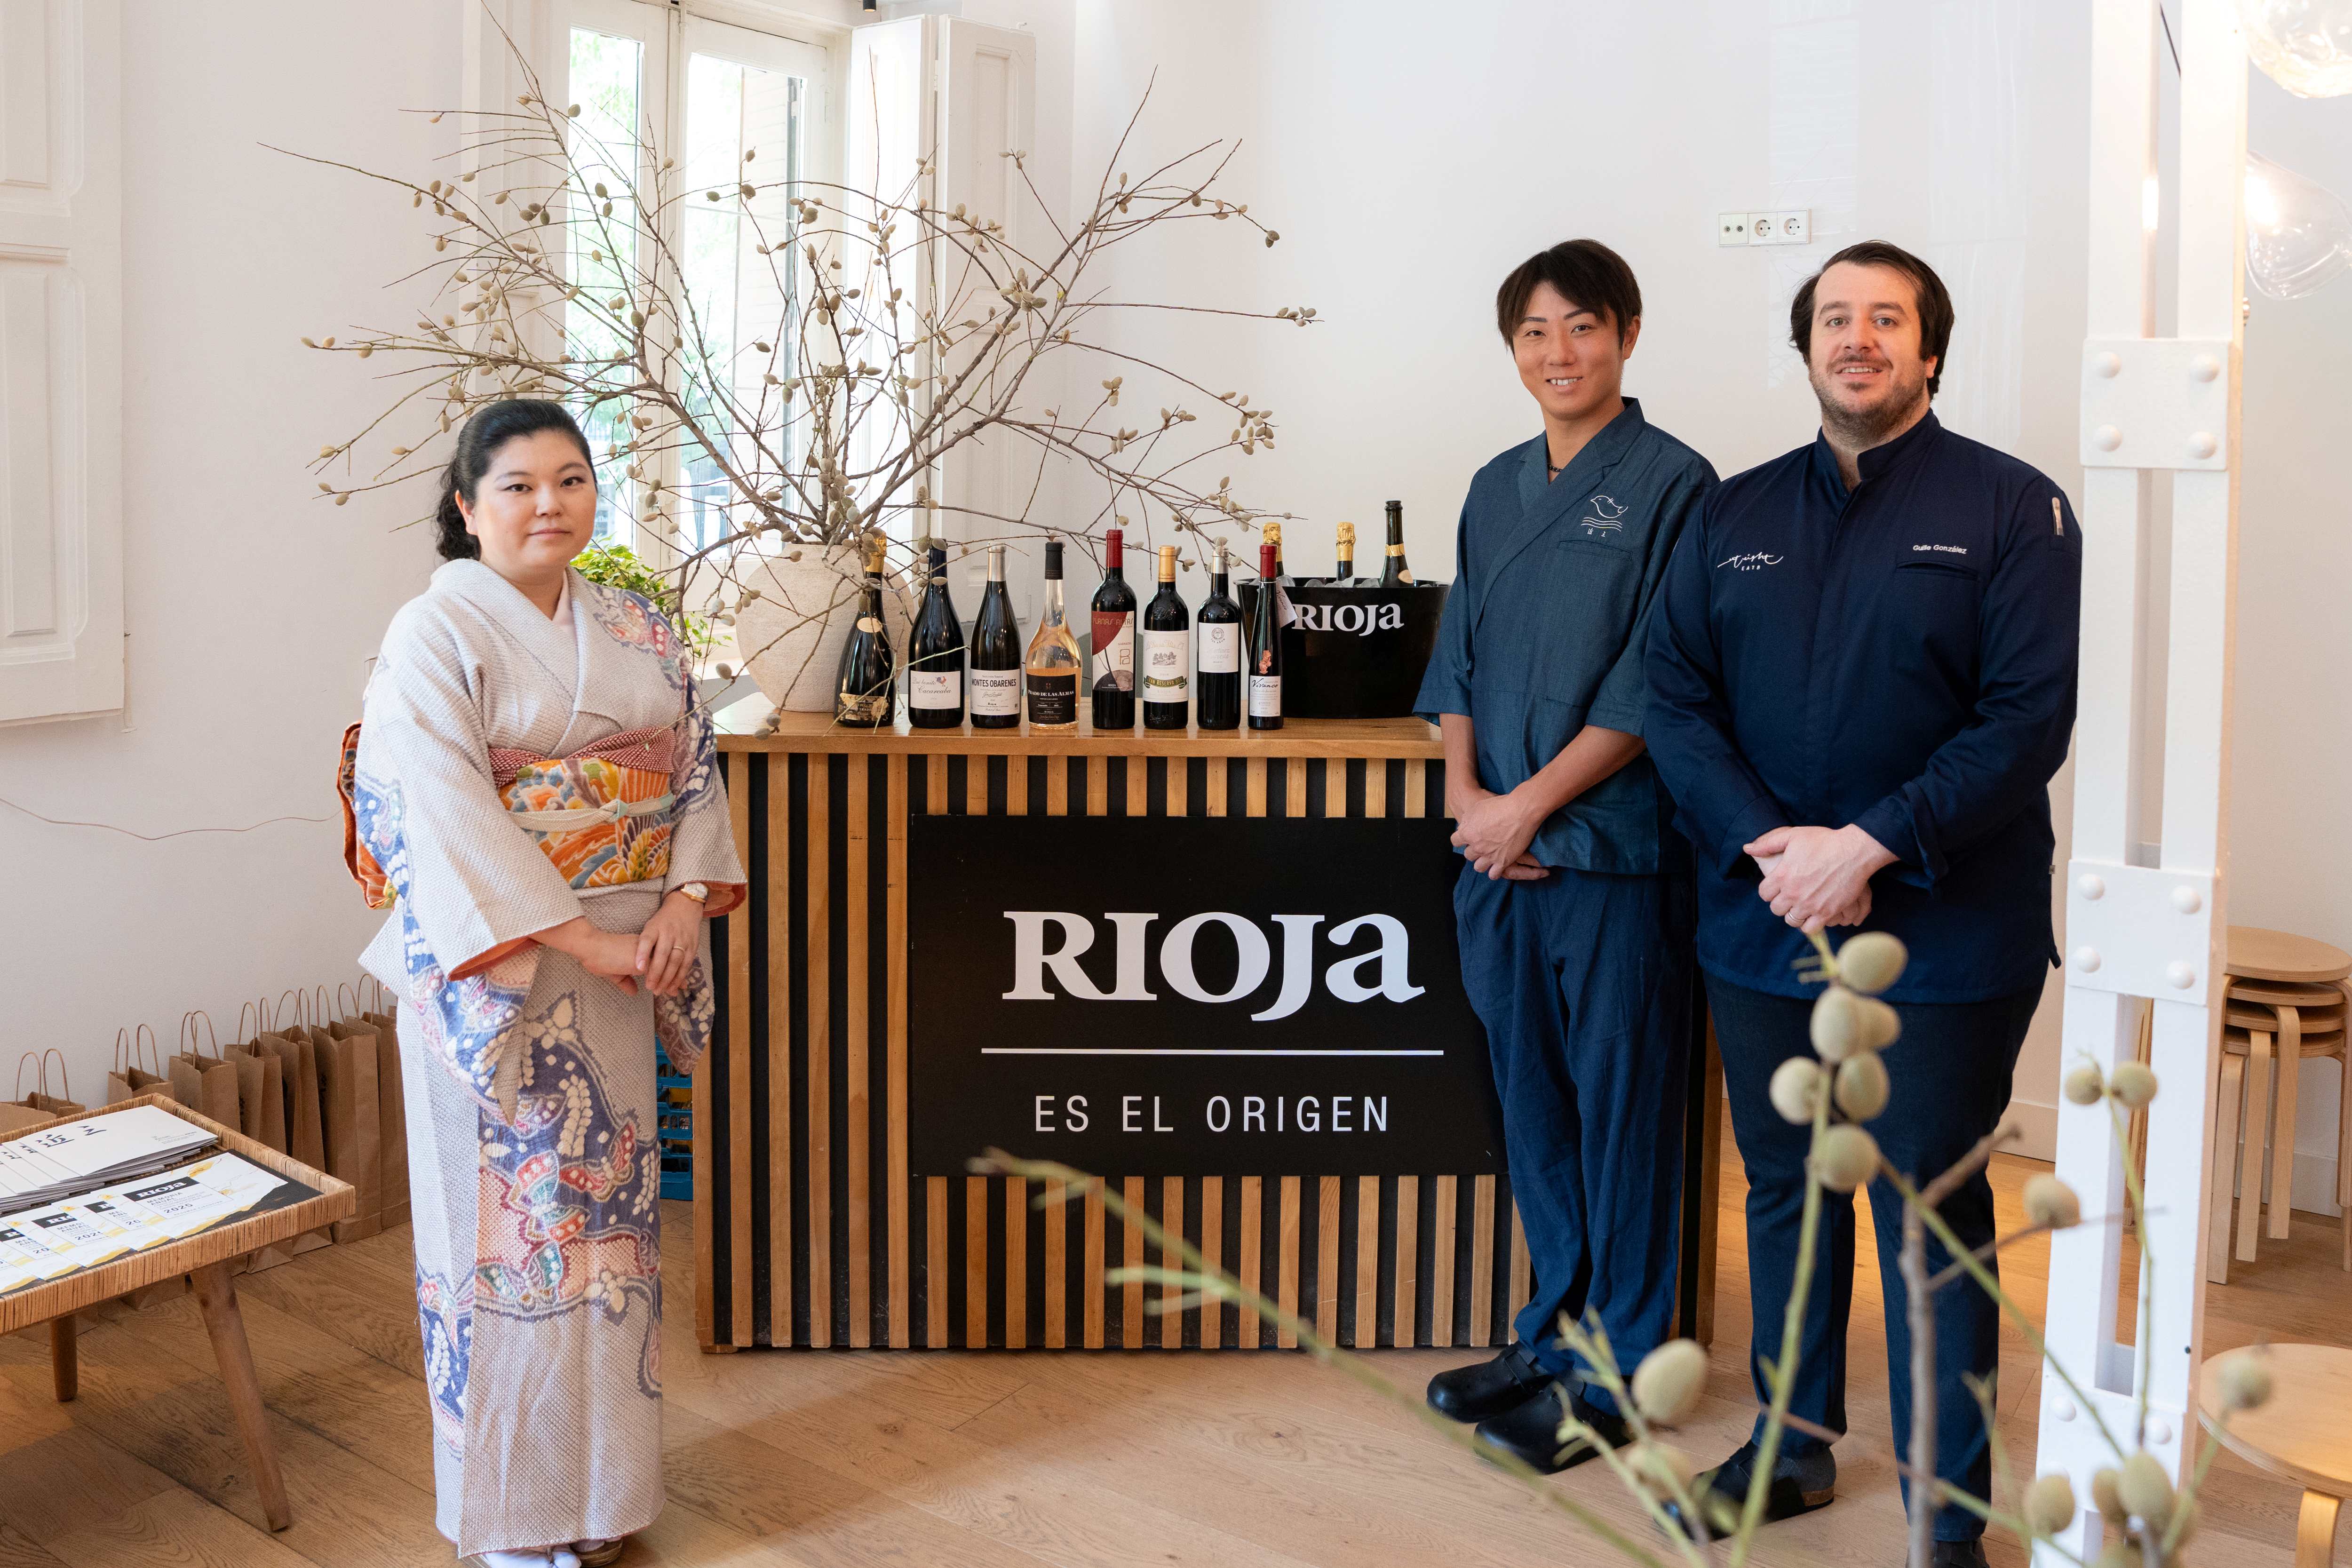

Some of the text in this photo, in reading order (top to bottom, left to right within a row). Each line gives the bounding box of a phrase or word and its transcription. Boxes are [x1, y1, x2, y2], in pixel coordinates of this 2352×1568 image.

[1933, 545, 1967, 554] González
[971, 678, 1017, 687] MONTES OBARENES
[1252, 678, 1278, 687] Vivanco
[1036, 1095, 1387, 1132] ES EL ORIGEN
[165, 1203, 193, 1213] 2025
